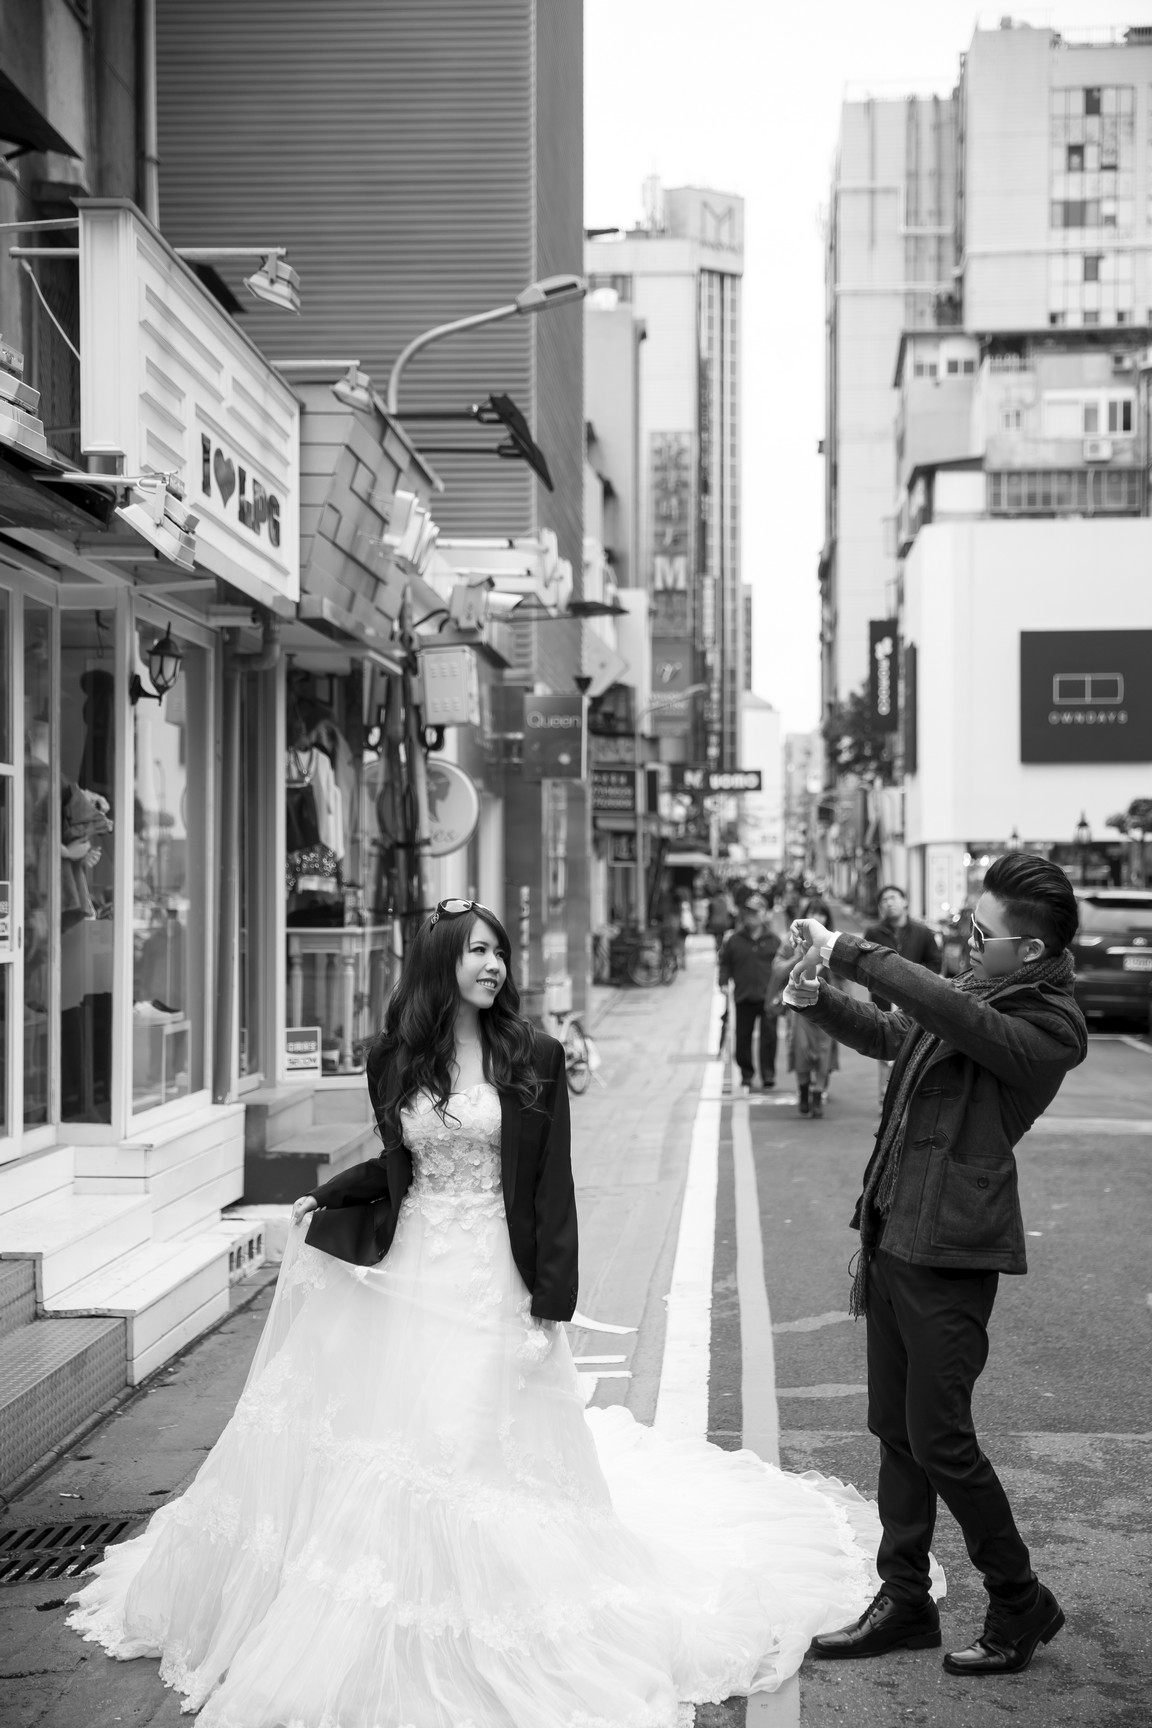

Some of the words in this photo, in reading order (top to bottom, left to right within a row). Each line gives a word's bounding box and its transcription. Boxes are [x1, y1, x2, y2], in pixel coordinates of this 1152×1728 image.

[201, 432, 211, 498] I
[238, 465, 280, 547] LPG
[527, 711, 582, 728] Queen
[1048, 710, 1128, 725] OWNDAYS
